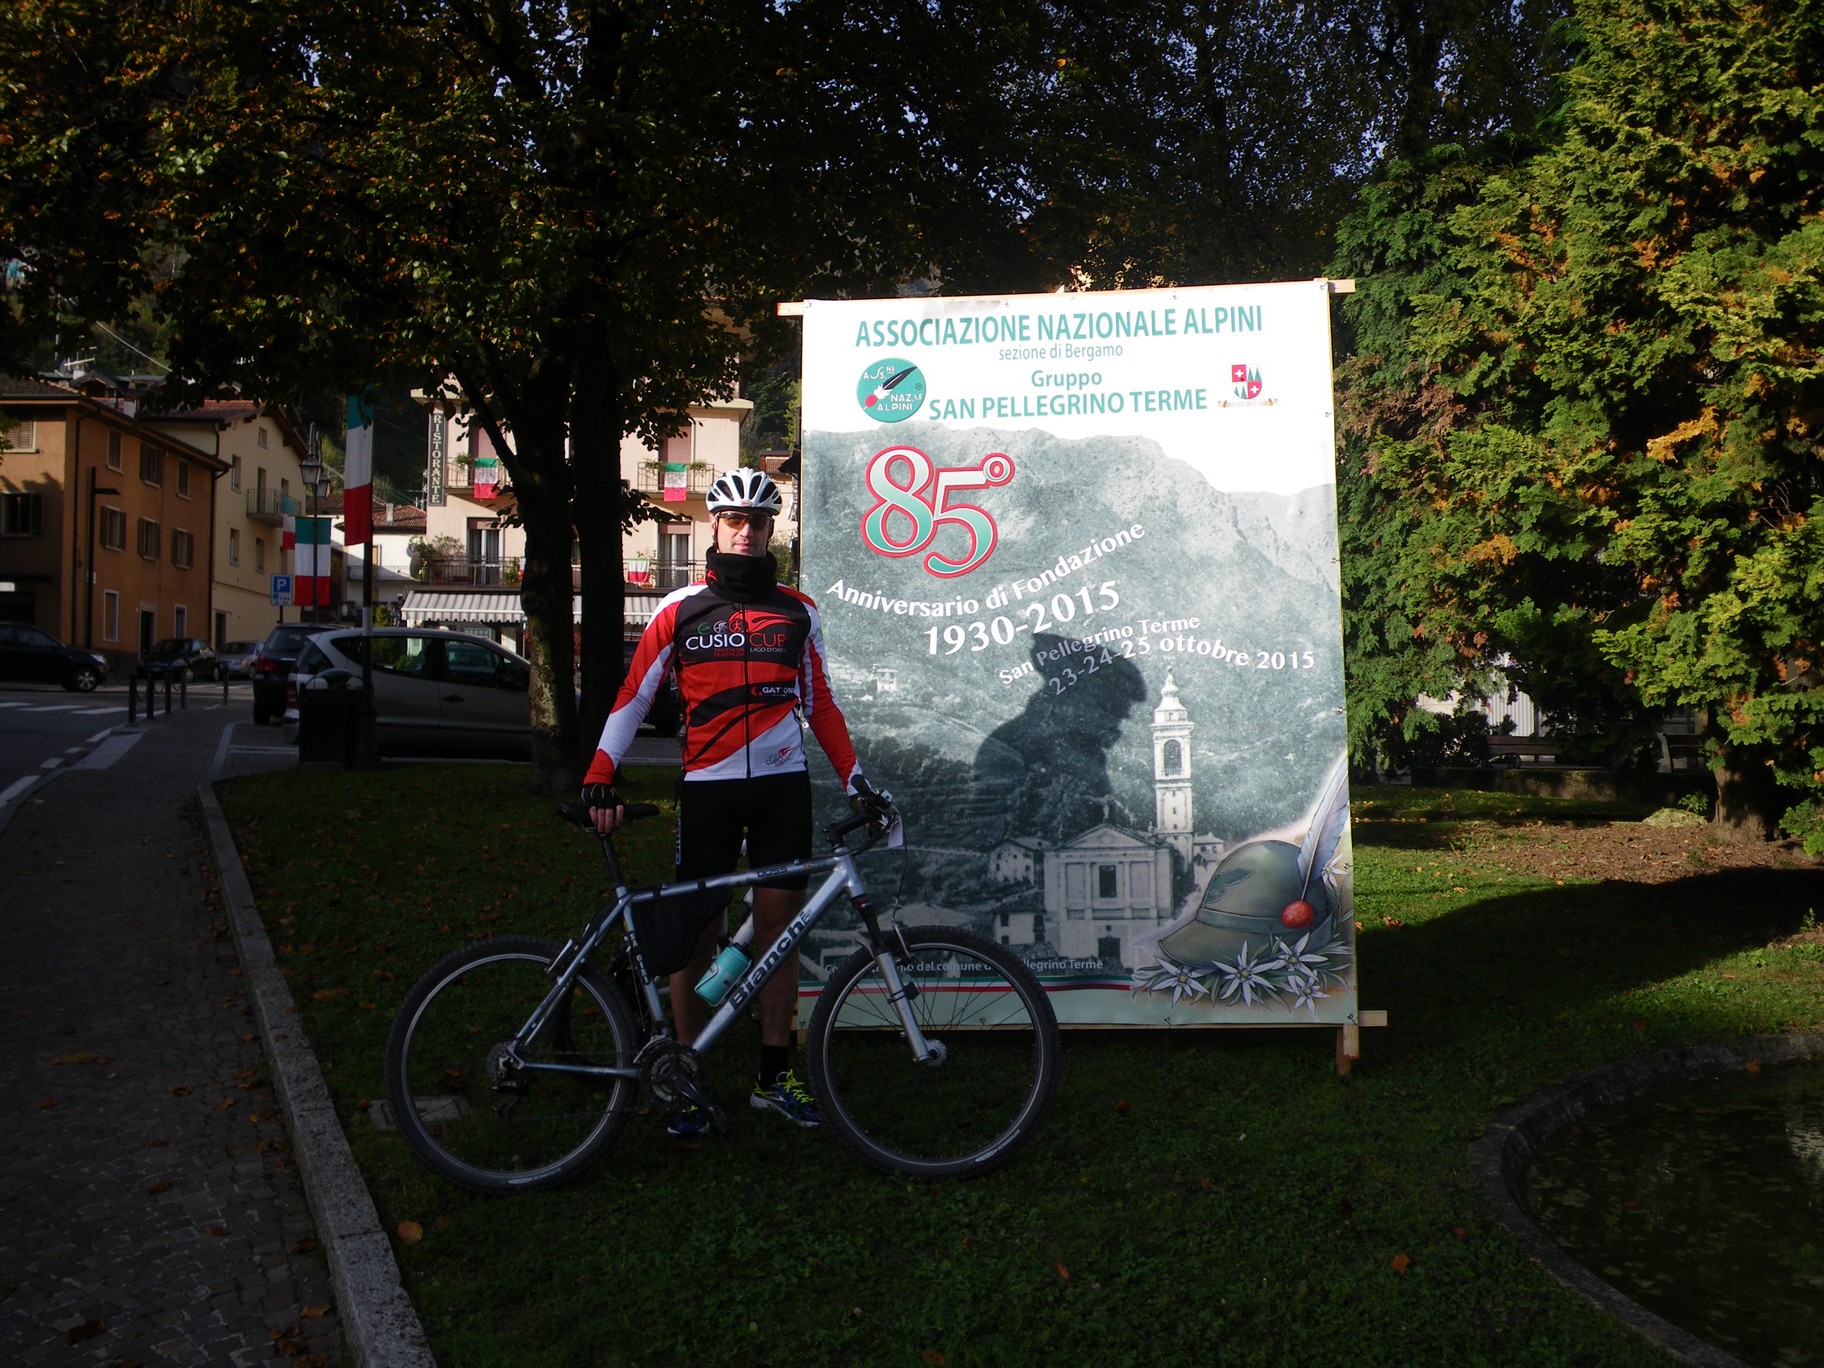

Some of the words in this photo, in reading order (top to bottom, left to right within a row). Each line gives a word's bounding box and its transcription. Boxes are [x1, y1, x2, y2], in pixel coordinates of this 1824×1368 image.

[855, 315, 1031, 347] ASSOCIAZIONE
[1037, 309, 1178, 341] NAZIONALE
[1183, 305, 1263, 335] ALPINI
[999, 345, 1047, 361] sezione
[1050, 343, 1062, 358] di
[1065, 342, 1124, 362] Bergamo
[1031, 369, 1103, 391] Gruppo
[877, 403, 913, 412] ALPINI
[929, 398, 976, 420] SAN
[982, 392, 1125, 418] PELLEGRINO
[1129, 388, 1208, 413] TERME
[431, 414, 441, 503] RISTORANTE
[825, 578, 979, 617] Anniversario
[986, 584, 1009, 611] di
[1011, 523, 1146, 601] Fondazione
[923, 579, 1122, 656] 1930-2015
[685, 633, 745, 651] CUSIO
[749, 633, 787, 648] CUP
[999, 660, 1034, 686] San
[1035, 624, 1134, 667] Pellegrino
[1136, 616, 1201, 635] Terme
[1048, 637, 1152, 696] 23-24-25
[1158, 634, 1250, 667] ottobre
[1256, 651, 1316, 671] 2015
[762, 686, 781, 694] GAT
[729, 909, 812, 1011] Bianchi
[916, 960, 934, 972] del
[936, 961, 982, 972] comune
[1069, 959, 1104, 970] Terme
